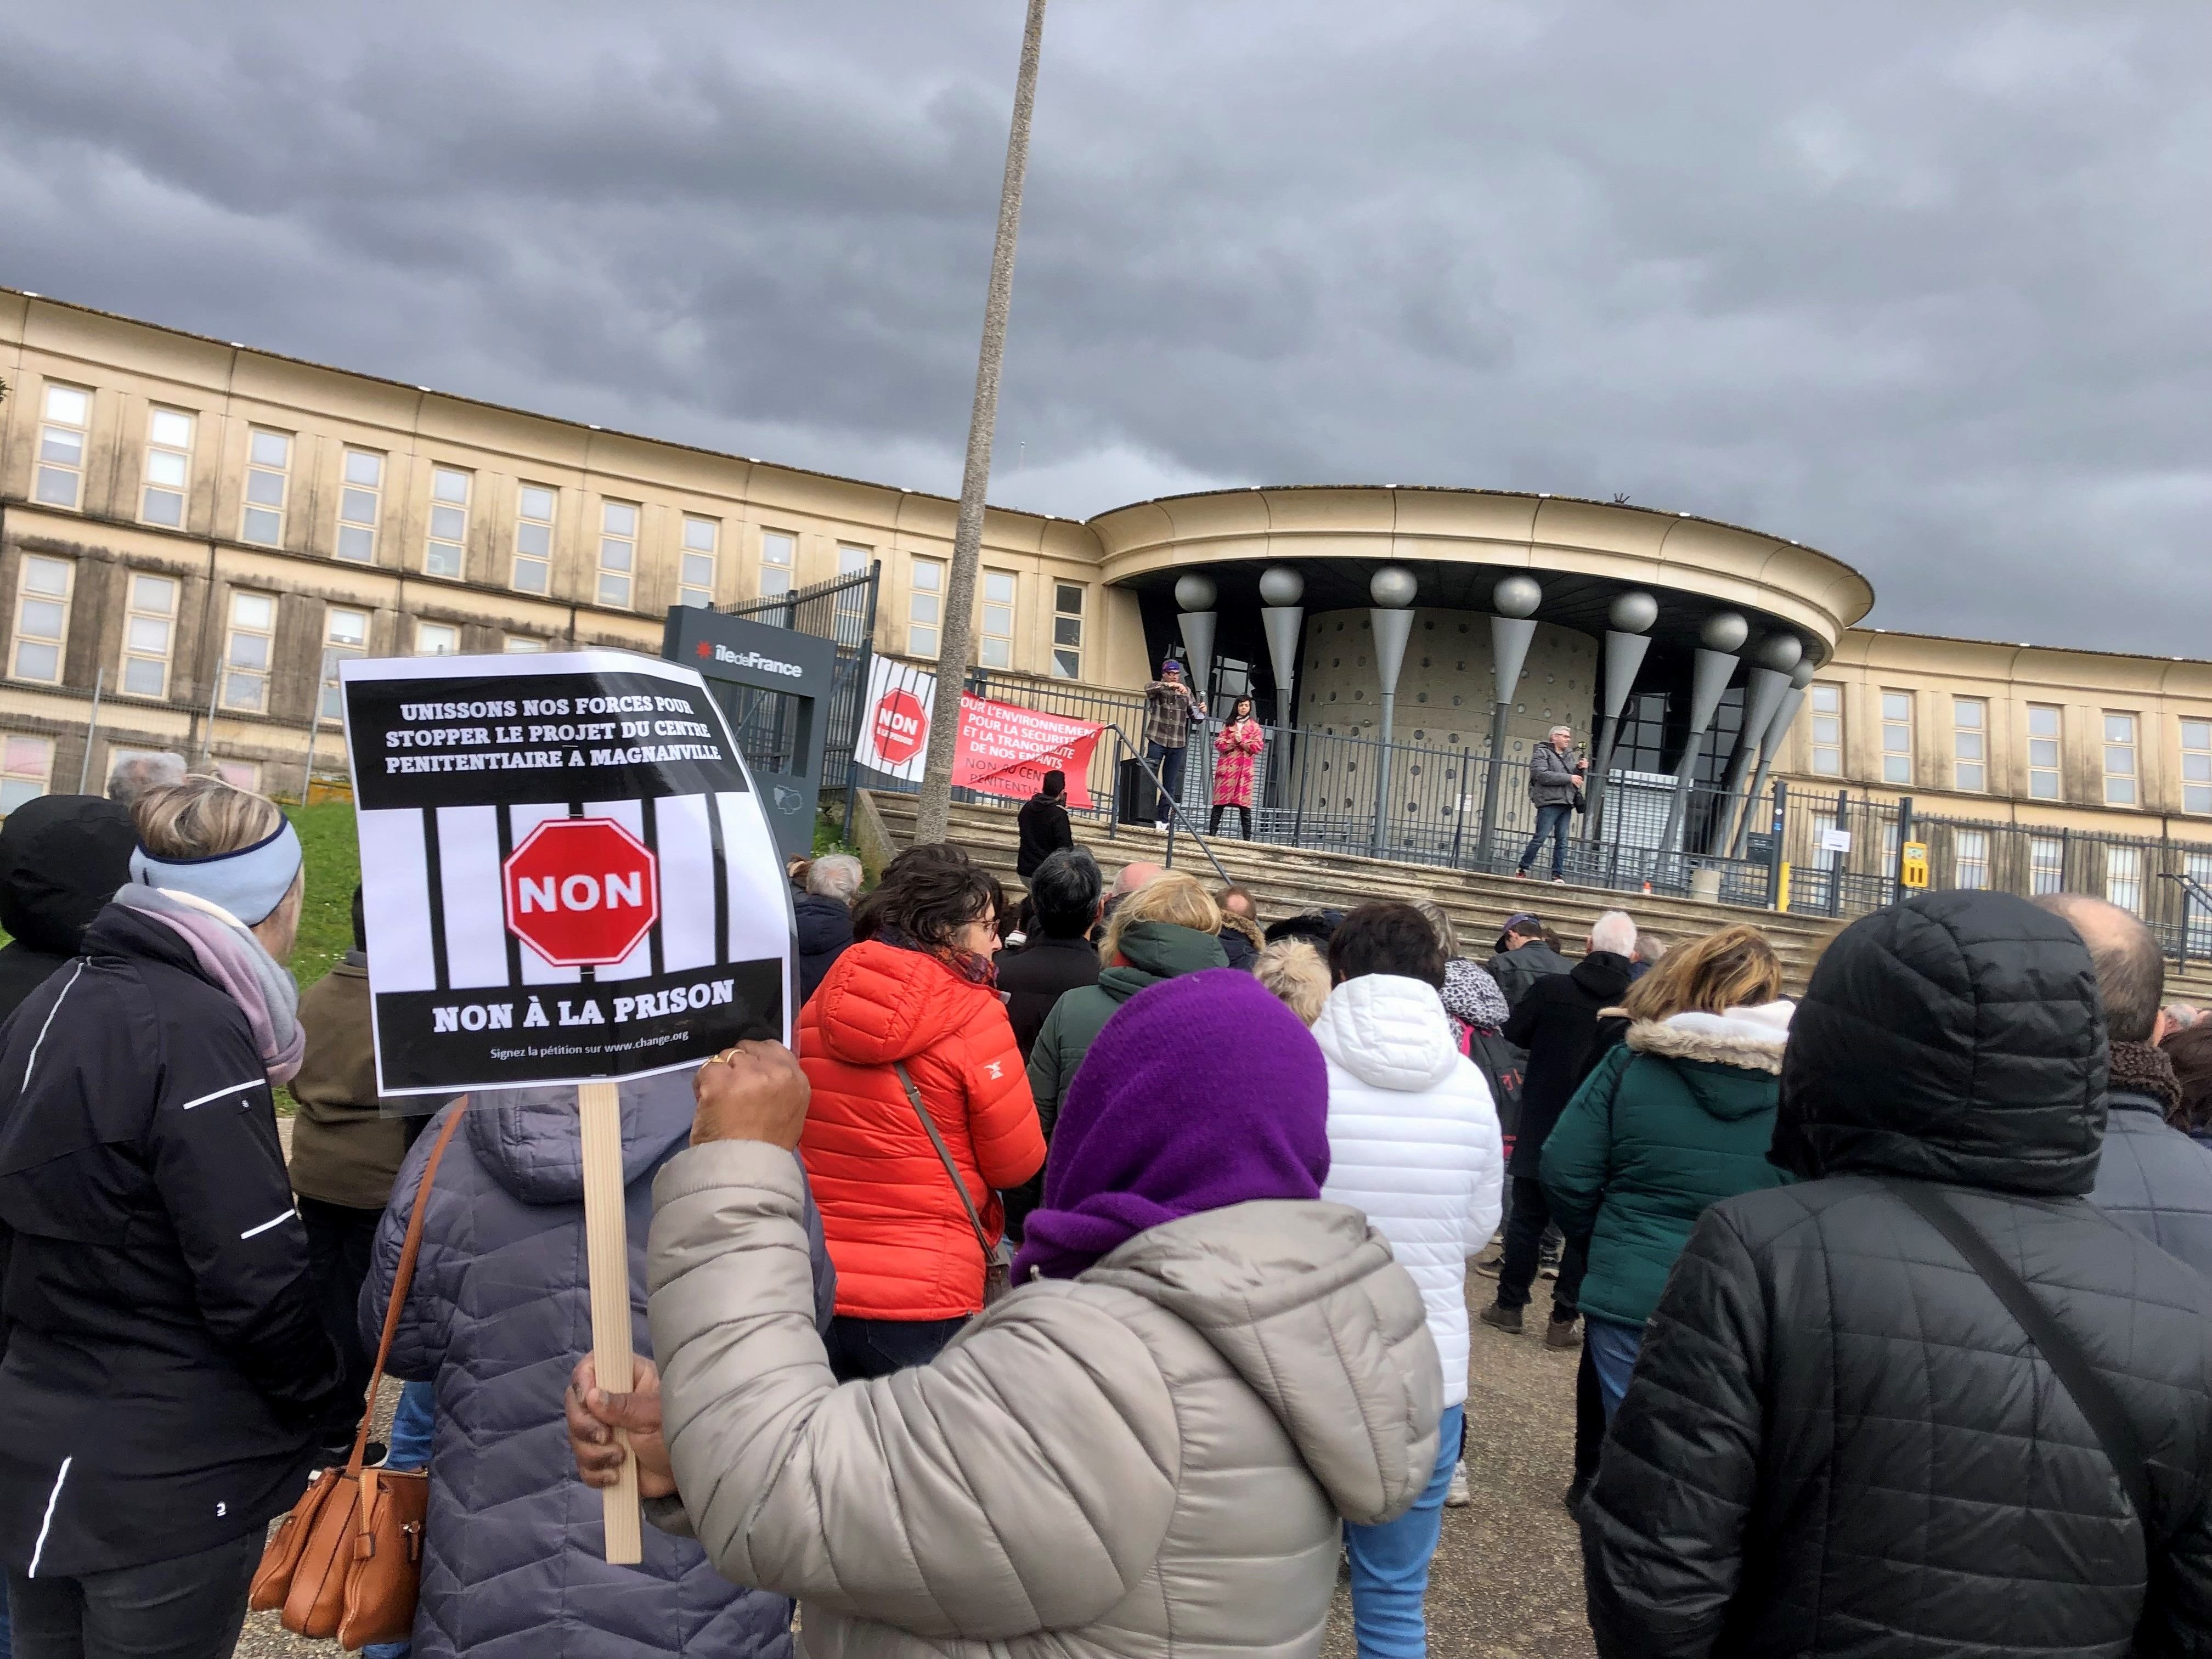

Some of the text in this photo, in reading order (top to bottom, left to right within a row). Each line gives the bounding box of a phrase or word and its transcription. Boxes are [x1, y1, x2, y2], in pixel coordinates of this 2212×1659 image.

[399, 696, 695, 721] UNISSONS NOS FORCES POUR
[961, 697, 985, 713] OUR
[385, 720, 712, 748] STOPPER LE PROJET DU CENTRE
[878, 707, 918, 736] NON
[963, 726, 978, 738] ET
[979, 731, 994, 743] LA
[968, 713, 1001, 732] POUR
[1003, 725, 1019, 736] LA
[385, 744, 722, 774] PENITENTIAIRE A MAGNANVILLE
[970, 741, 986, 754] DE
[989, 746, 1015, 760] NOS
[966, 758, 997, 771] NON
[518, 871, 643, 915] NON
[432, 979, 735, 1033] NON À LA PRISON
[490, 1031, 689, 1060] Signez la pétition sur www.change.org
